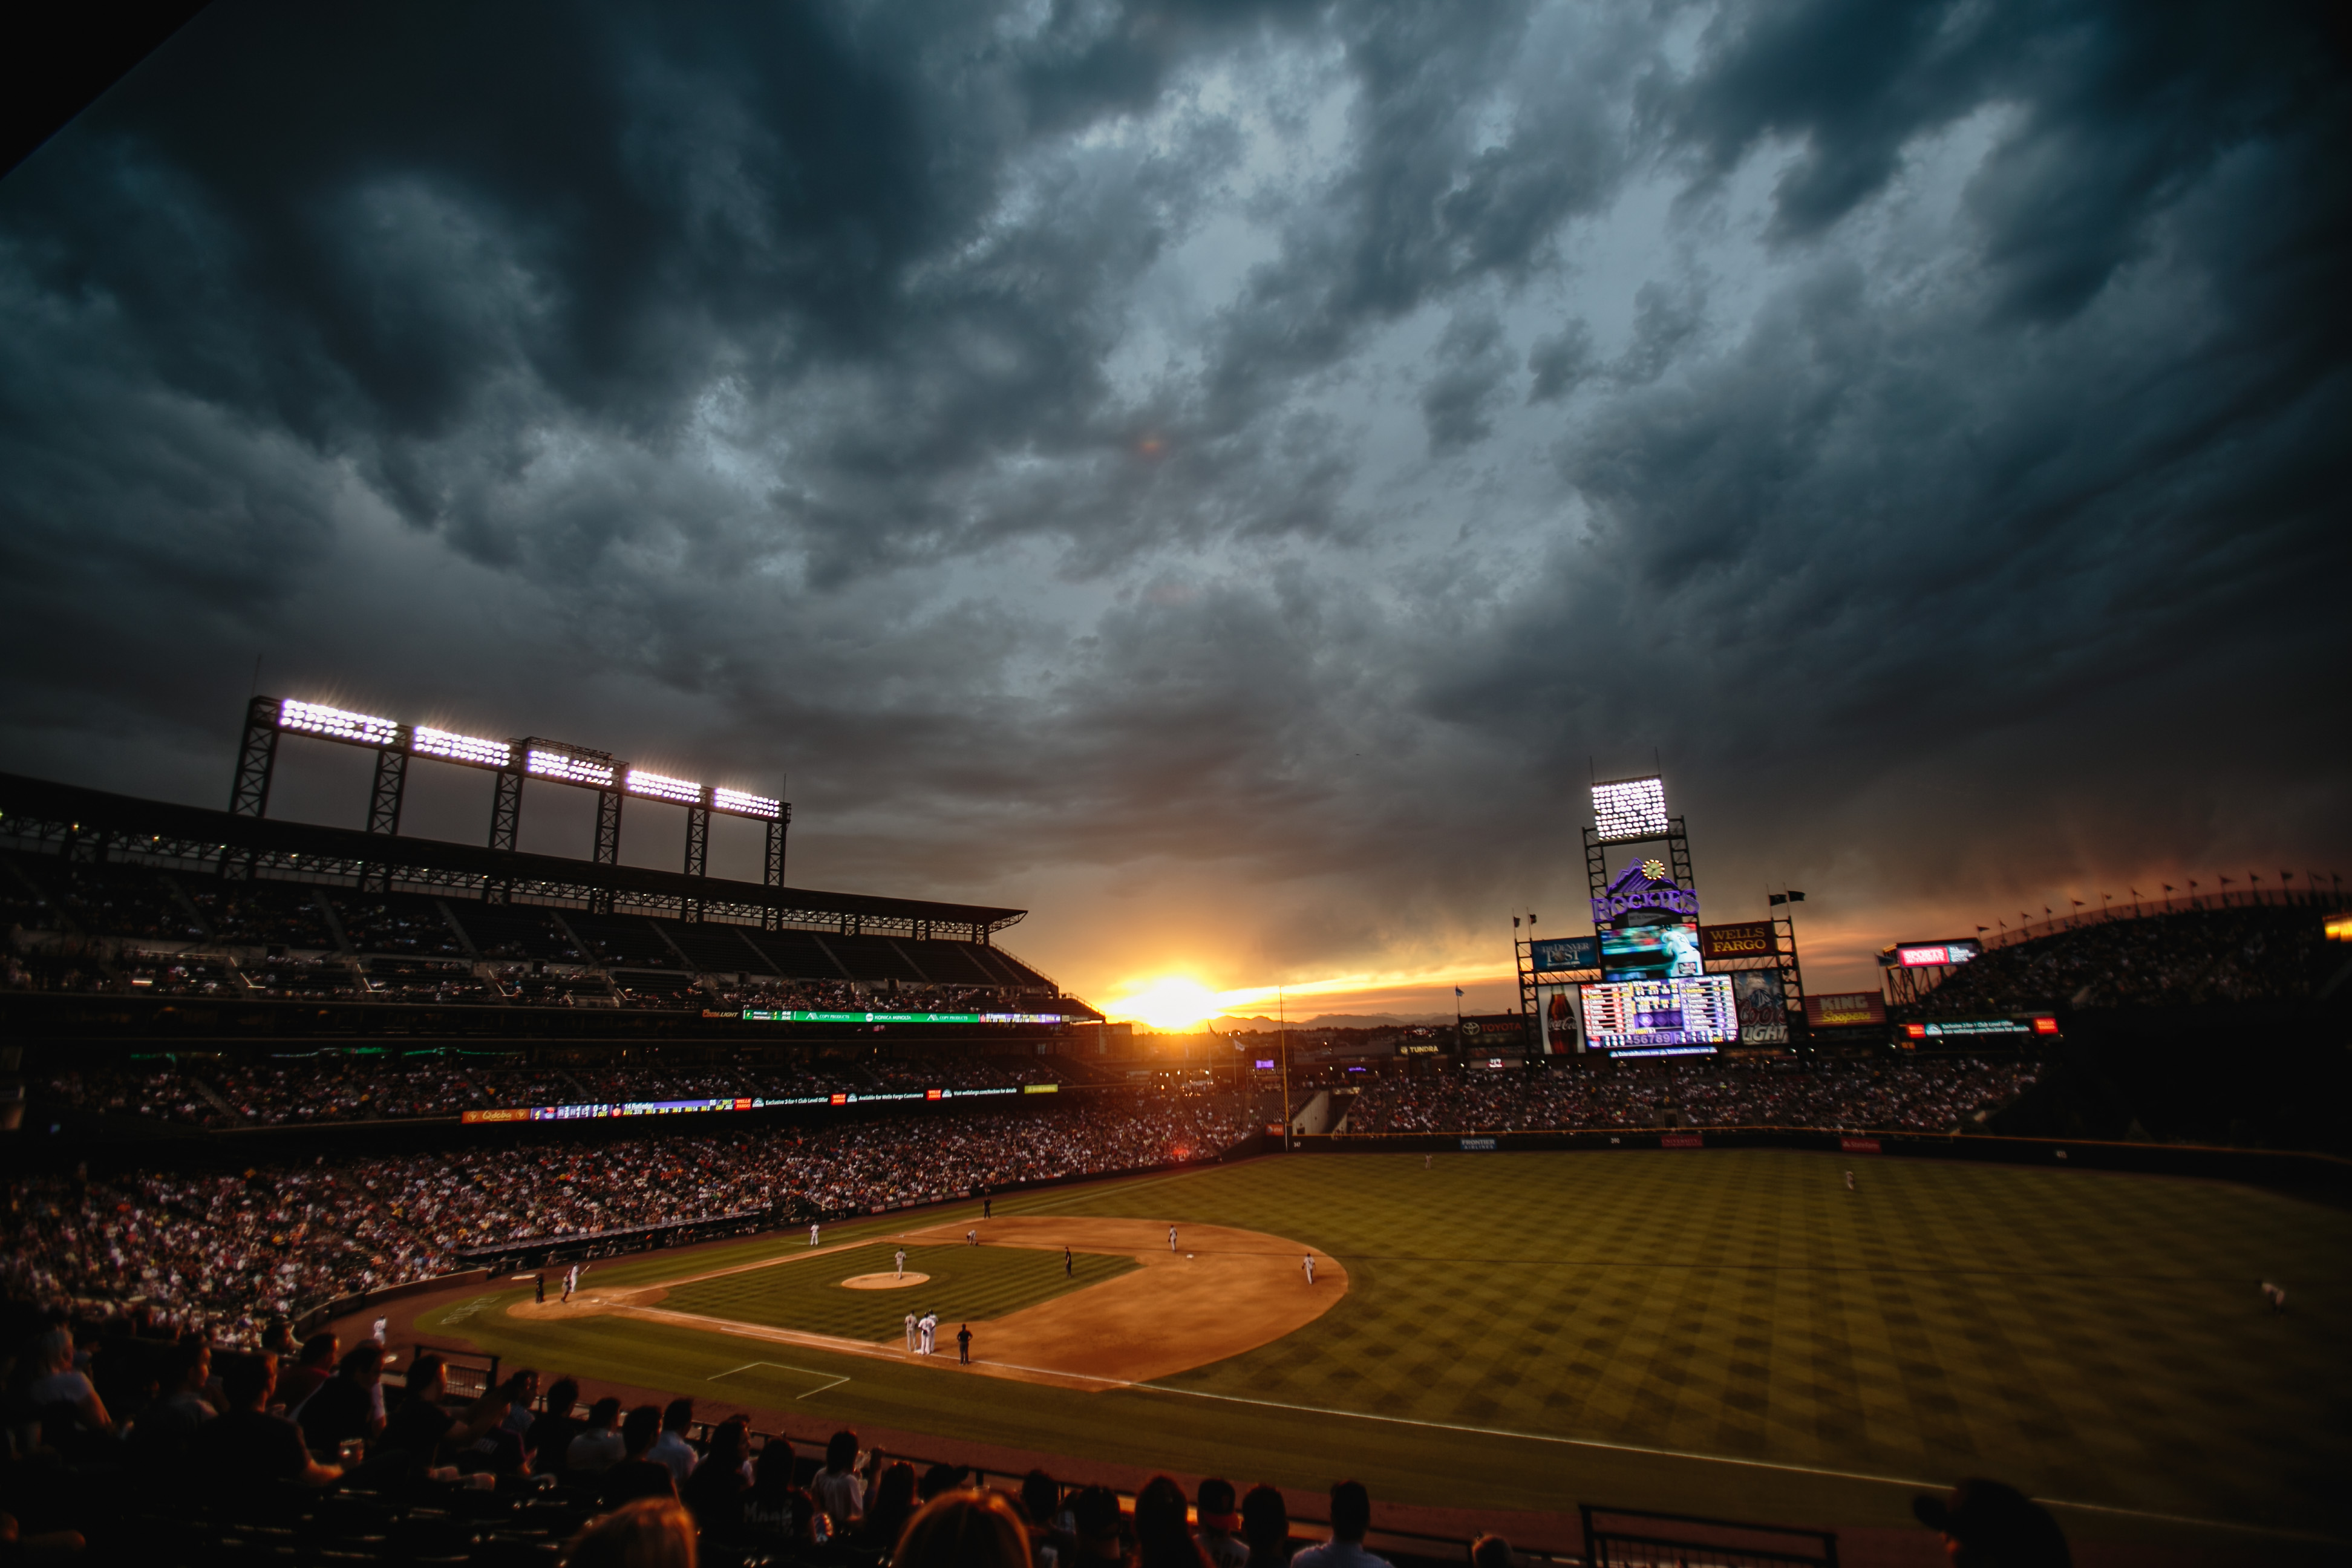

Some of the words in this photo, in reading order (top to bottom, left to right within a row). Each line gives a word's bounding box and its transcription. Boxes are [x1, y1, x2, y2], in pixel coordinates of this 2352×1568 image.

[1590, 889, 1700, 922] ROCKIES
[1710, 927, 1765, 940] WELLS
[1553, 942, 1590, 952] DENVER
[1713, 939, 1766, 952] FARGO
[1905, 949, 1944, 959] SPORTS
[1820, 996, 1869, 1011] KING
[1738, 999, 1787, 1027] Coors
[1822, 1011, 1871, 1024] Soopers
[1481, 1022, 1523, 1033] TOYOTA
[1742, 1025, 1789, 1041] LIGHT
[483, 1111, 512, 1121] Qdoba
